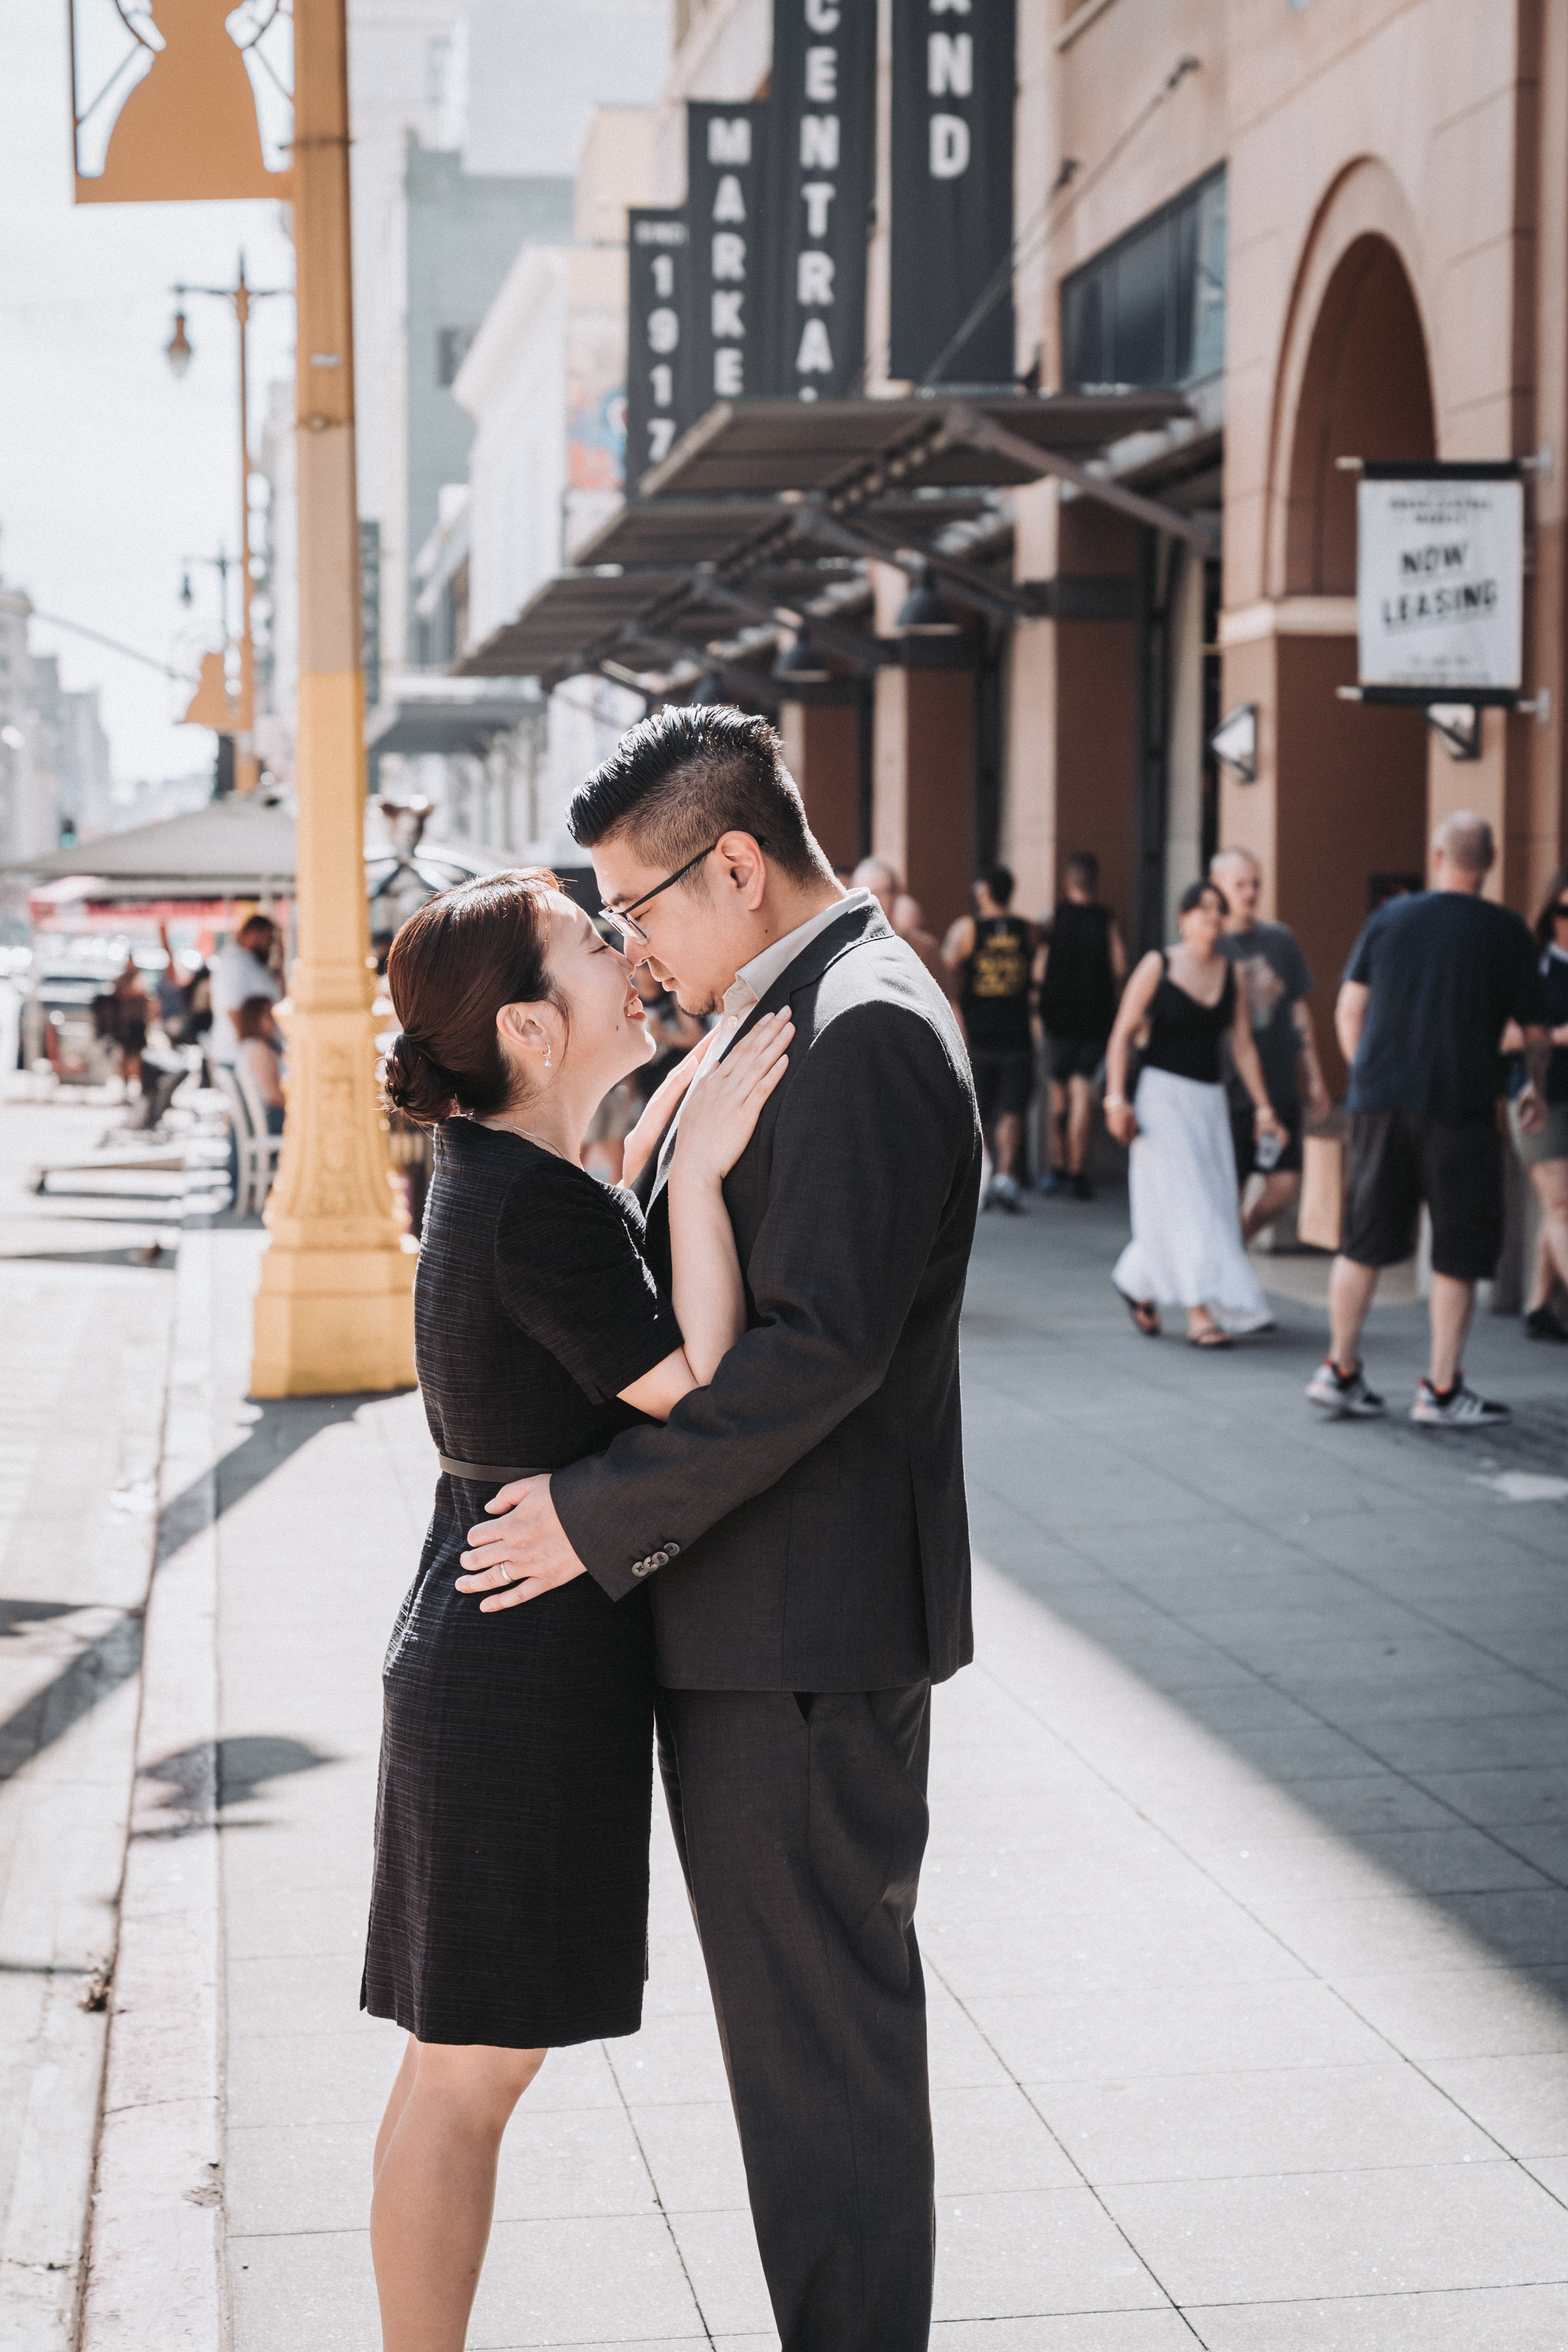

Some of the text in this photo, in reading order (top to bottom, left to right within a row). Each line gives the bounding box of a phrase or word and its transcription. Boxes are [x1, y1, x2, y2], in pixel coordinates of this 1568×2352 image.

[927, 0, 971, 178] ND
[707, 117, 752, 396] MARKE
[796, 0, 841, 401] CENTRA
[648, 254, 679, 463] 1917
[1383, 578, 1497, 625] LEASING
[1401, 540, 1468, 575] NOW
